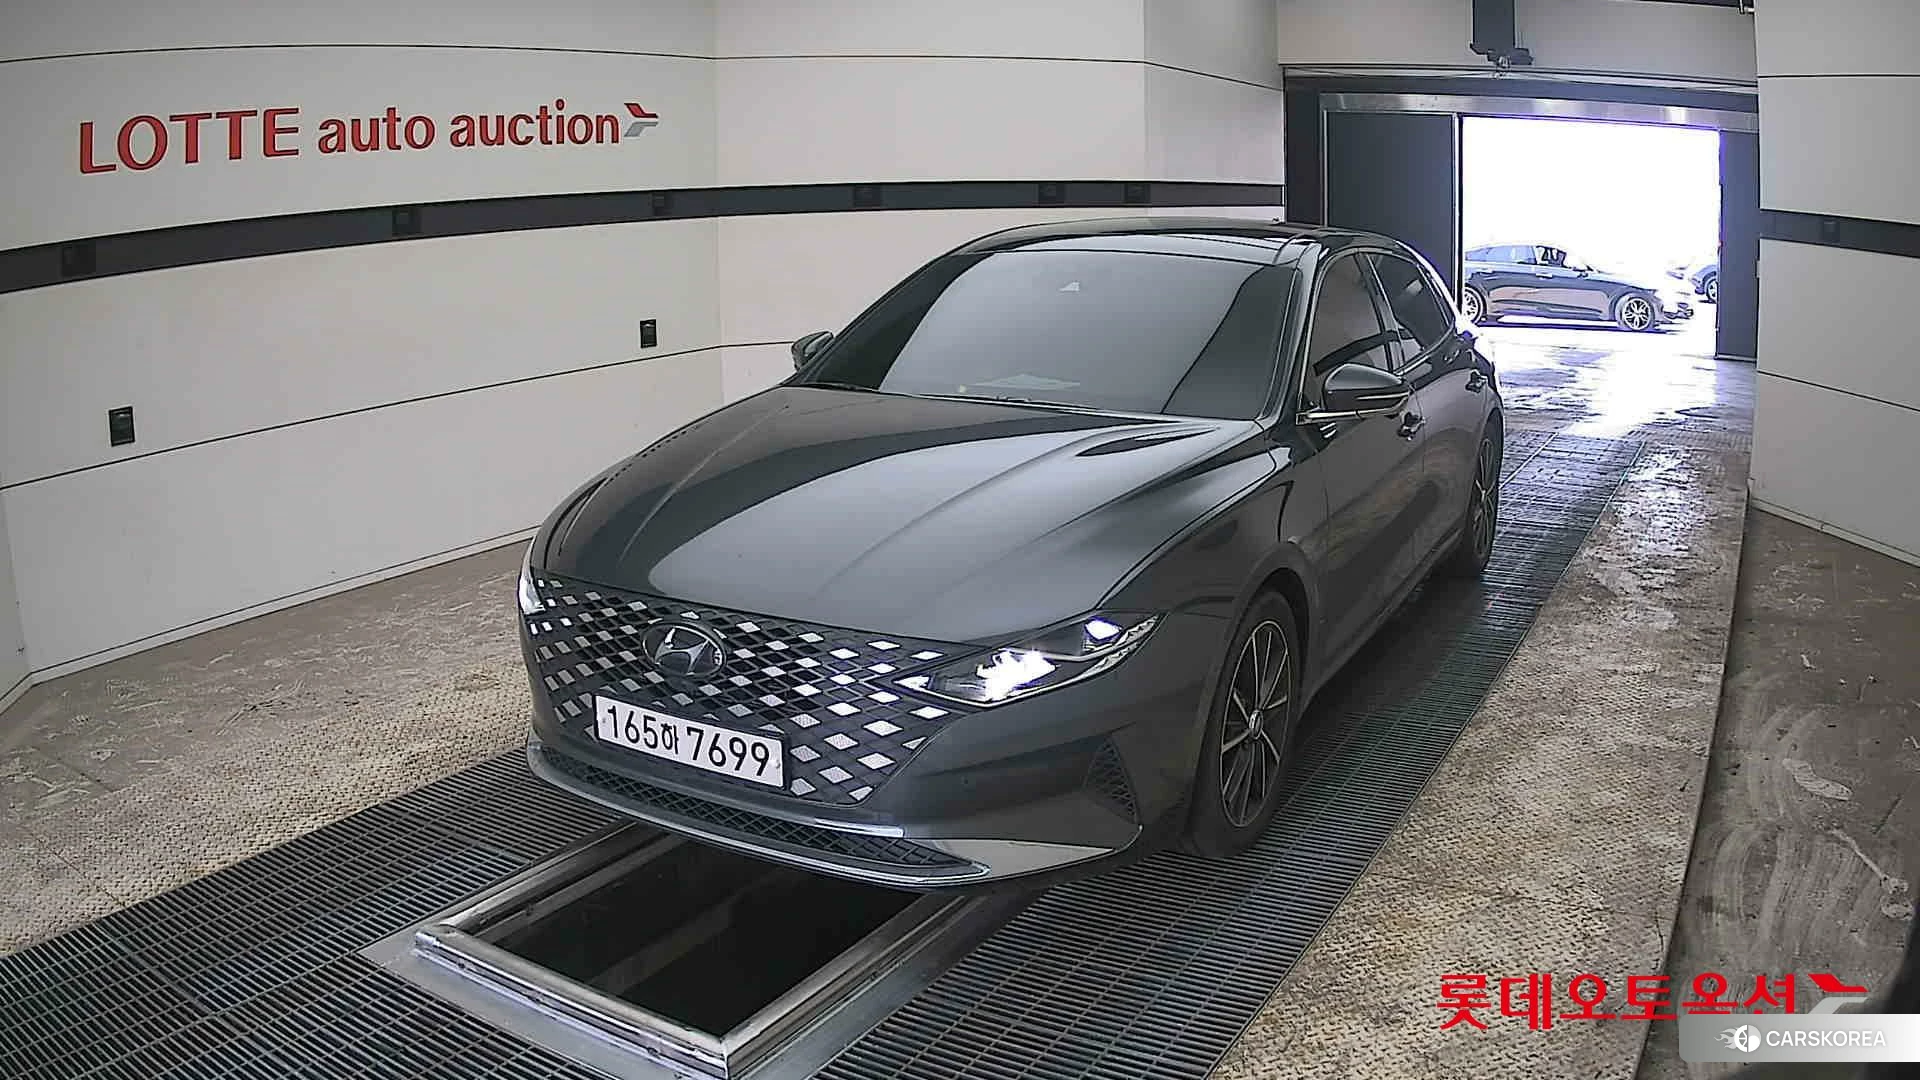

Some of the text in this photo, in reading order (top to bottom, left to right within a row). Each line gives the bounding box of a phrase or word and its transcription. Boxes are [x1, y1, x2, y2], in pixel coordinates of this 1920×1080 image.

[79, 98, 621, 174] LOTTE auto auction
[686, 726, 770, 776] 7699
